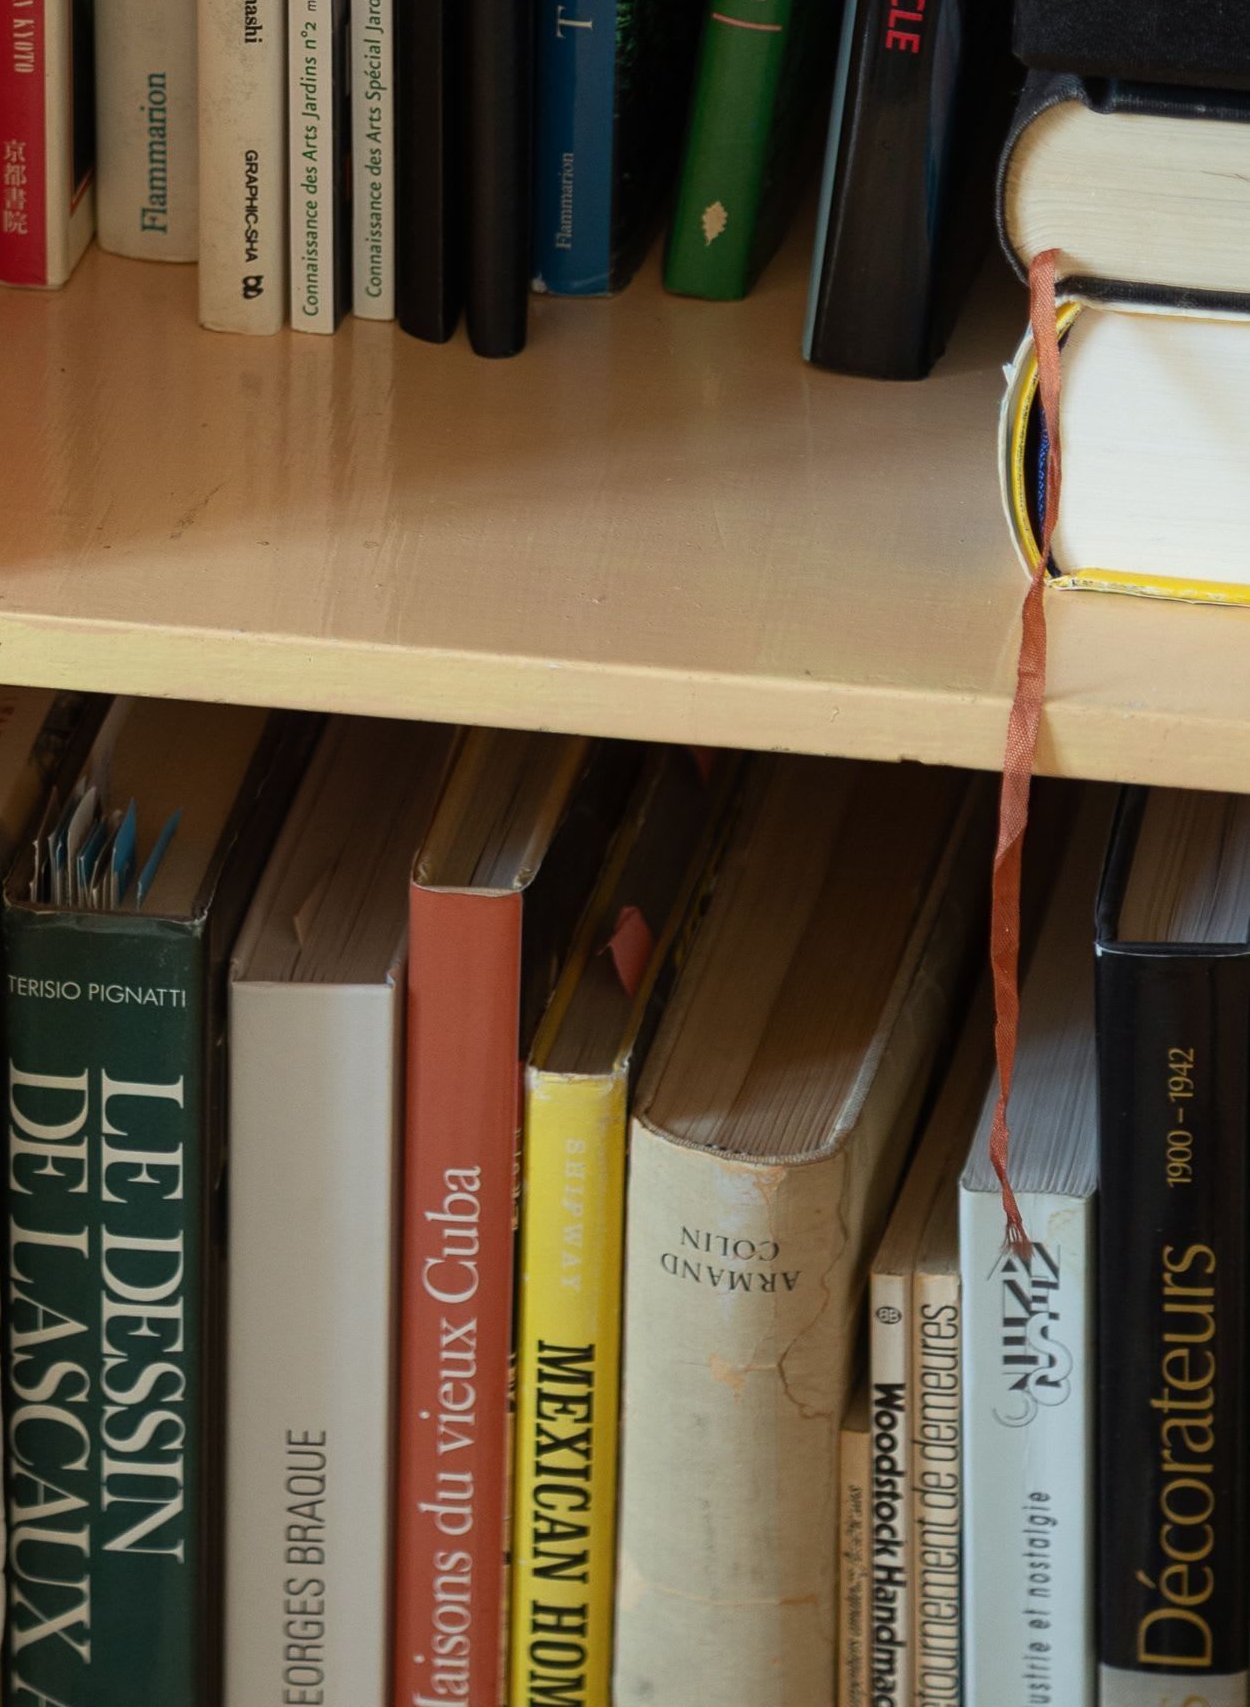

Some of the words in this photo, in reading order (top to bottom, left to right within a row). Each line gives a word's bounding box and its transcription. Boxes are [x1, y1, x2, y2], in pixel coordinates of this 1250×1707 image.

[13, 18, 35, 73] KYOTO
[300, 22, 318, 50] n°2
[363, 38, 387, 101] Spécial
[299, 57, 321, 120] Jardins
[364, 107, 382, 143] Arts
[2, 139, 29, 235] 京都書院
[139, 72, 168, 234] Flammarion
[300, 125, 318, 162] Arts
[301, 166, 319, 195] des
[364, 147, 382, 176] des
[244, 149, 259, 263] GRAPHIC-SHA
[364, 182, 383, 298] Connaissance
[555, 153, 575, 249] Flammarion
[301, 200, 320, 317] Connaissance
[7, 974, 81, 1001] TERISIO
[88, 981, 187, 1010] PIGNATTI
[9, 1057, 89, 1195] DE
[1167, 1048, 1195, 1103] 1942
[100, 1069, 185, 1204] LE
[1165, 1129, 1194, 1188] 1900
[421, 1165, 482, 1304] Cuba
[560, 1138, 587, 1293] SHIPWAY
[680, 1226, 780, 1262] COLIN
[661, 1252, 800, 1294] ARMAND
[100, 1224, 186, 1564] DESSIN
[418, 1317, 477, 1455] vieux
[911, 1304, 960, 1463] demeures
[9, 1215, 91, 1665] LASCAUX
[531, 1339, 595, 1584] MEXICAN
[871, 1382, 907, 1558] Woodstock
[1135, 1243, 1217, 1668] Décorateurs
[284, 1429, 327, 1565] BRAQUE
[417, 1471, 474, 1535] du
[911, 1472, 961, 1510] de
[1021, 1491, 1057, 1598] nostalgie
